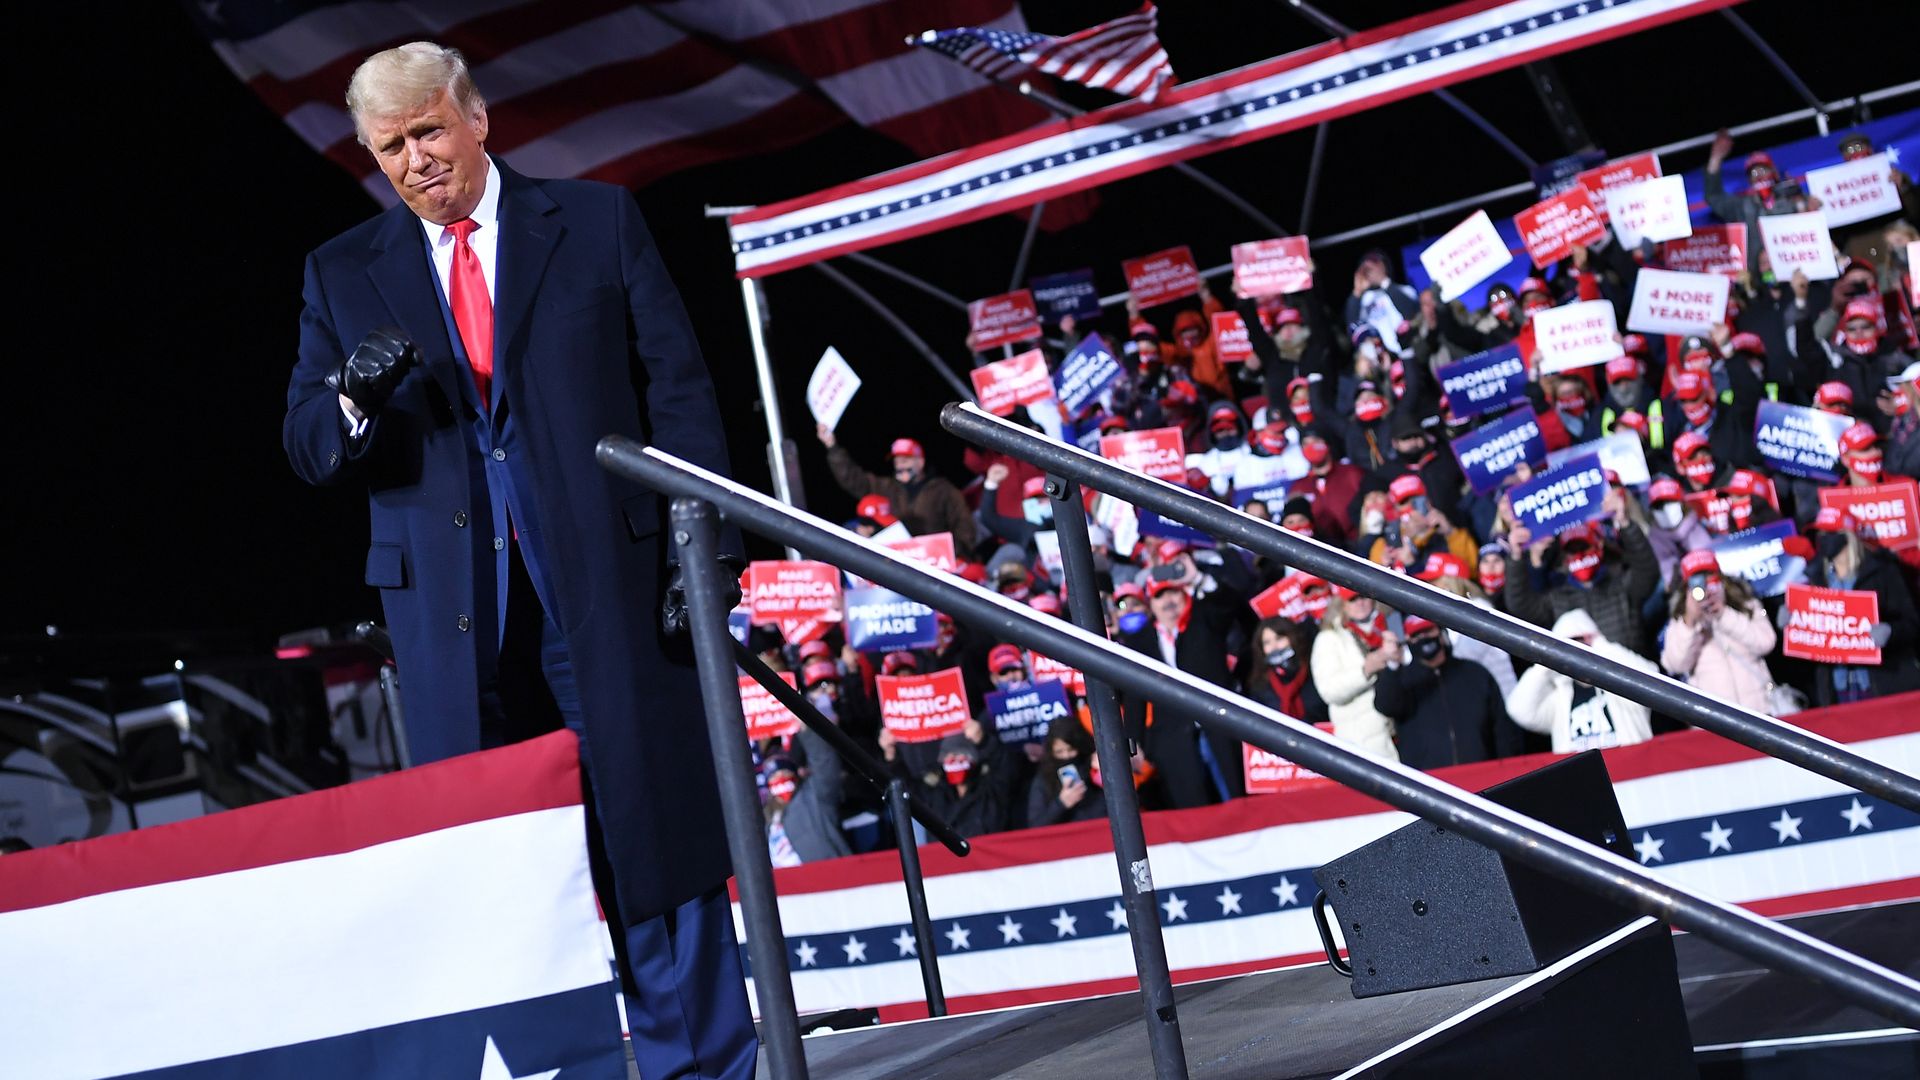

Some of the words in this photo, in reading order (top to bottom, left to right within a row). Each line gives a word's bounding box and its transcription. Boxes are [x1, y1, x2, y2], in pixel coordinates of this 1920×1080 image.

[1823, 185, 1833, 196] 4
[1836, 172, 1881, 192] MORE
[1829, 186, 1884, 210] YEARS!
[1526, 204, 1595, 246] AMERICA
[1781, 231, 1818, 244] MORE
[1670, 243, 1743, 263] AMERICA
[1778, 248, 1820, 263] YEARS!
[1132, 263, 1194, 289] AMERICA
[1239, 255, 1308, 276] AMERICA
[1648, 288, 1660, 299] 4
[1665, 289, 1715, 304] MORE
[1648, 305, 1711, 321] YEARS!
[1560, 317, 1605, 333] MORE
[1551, 334, 1610, 352] YEARS!
[1443, 357, 1524, 394] PROMISES
[1466, 378, 1508, 402] KEPT
[1460, 421, 1539, 470] PROMISES
[1485, 443, 1527, 475] KEPT
[1513, 468, 1603, 518] PROMISES
[1534, 489, 1590, 524] MADE
[776, 569, 813, 581] MAKE
[756, 581, 836, 598] AMERICA
[1808, 597, 1846, 616] MAKE
[865, 617, 918, 636] MADE
[1790, 609, 1872, 635] AMERICA
[1788, 628, 1829, 647] GREAT
[1828, 633, 1876, 650] AGAIN
[897, 684, 935, 699] MAKE
[1005, 692, 1040, 712] MAKE
[883, 692, 963, 717] AMERICA
[884, 716, 921, 731] GREAT
[922, 708, 966, 728] AGAIN
[995, 701, 1068, 730] AMERICA
[1249, 766, 1295, 782] GREAT
